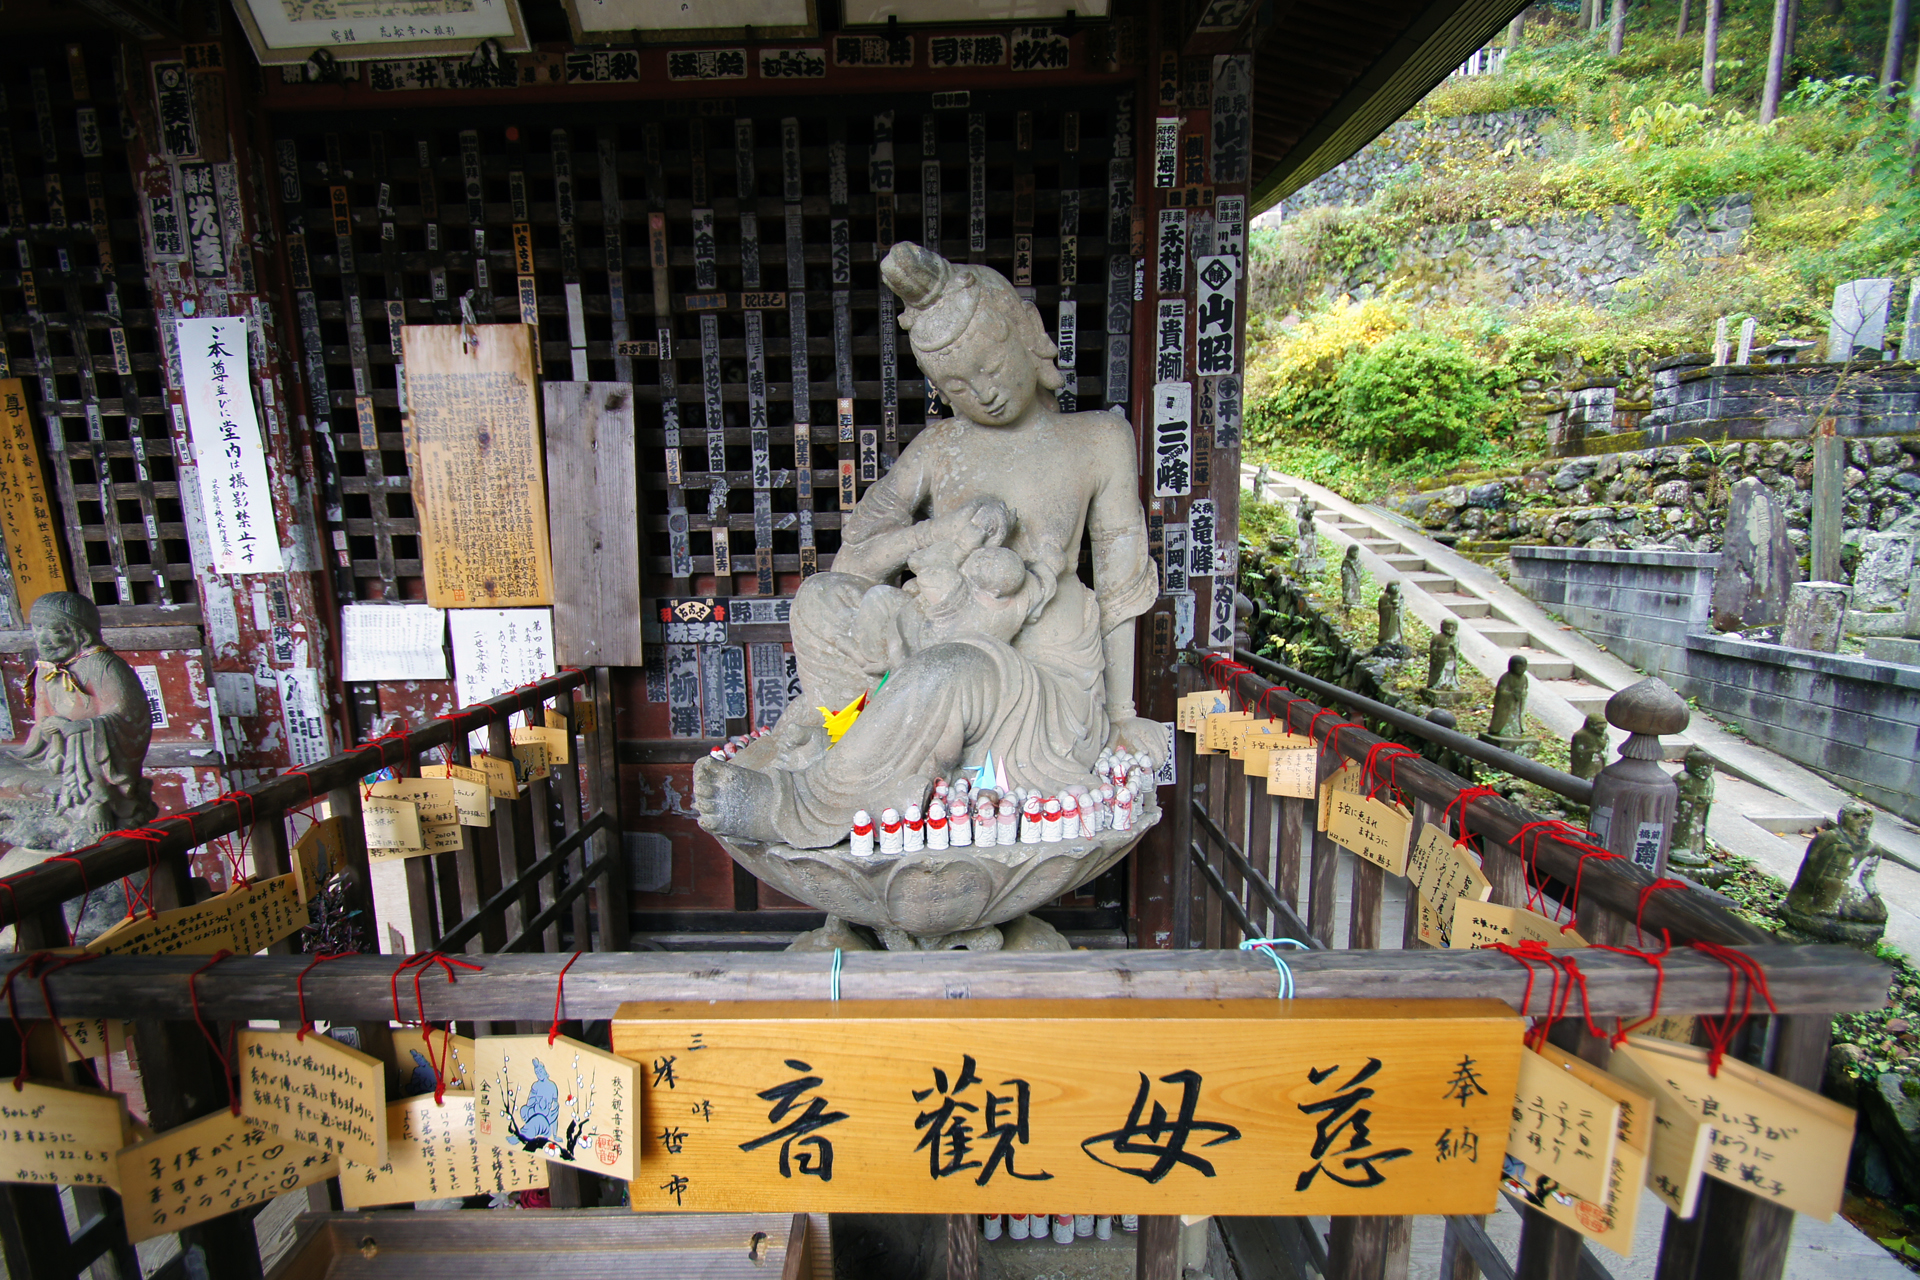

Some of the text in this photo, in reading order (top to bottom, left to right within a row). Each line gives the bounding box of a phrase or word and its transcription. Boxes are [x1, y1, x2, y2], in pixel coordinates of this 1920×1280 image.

[207, 325, 256, 565] ご本尊並びに堂内は撮影禁止です
[478, 1078, 492, 1122] 金昌寺
[610, 1075, 624, 1157] 秩父観音霊場
[1434, 1054, 1490, 1164] 奉納
